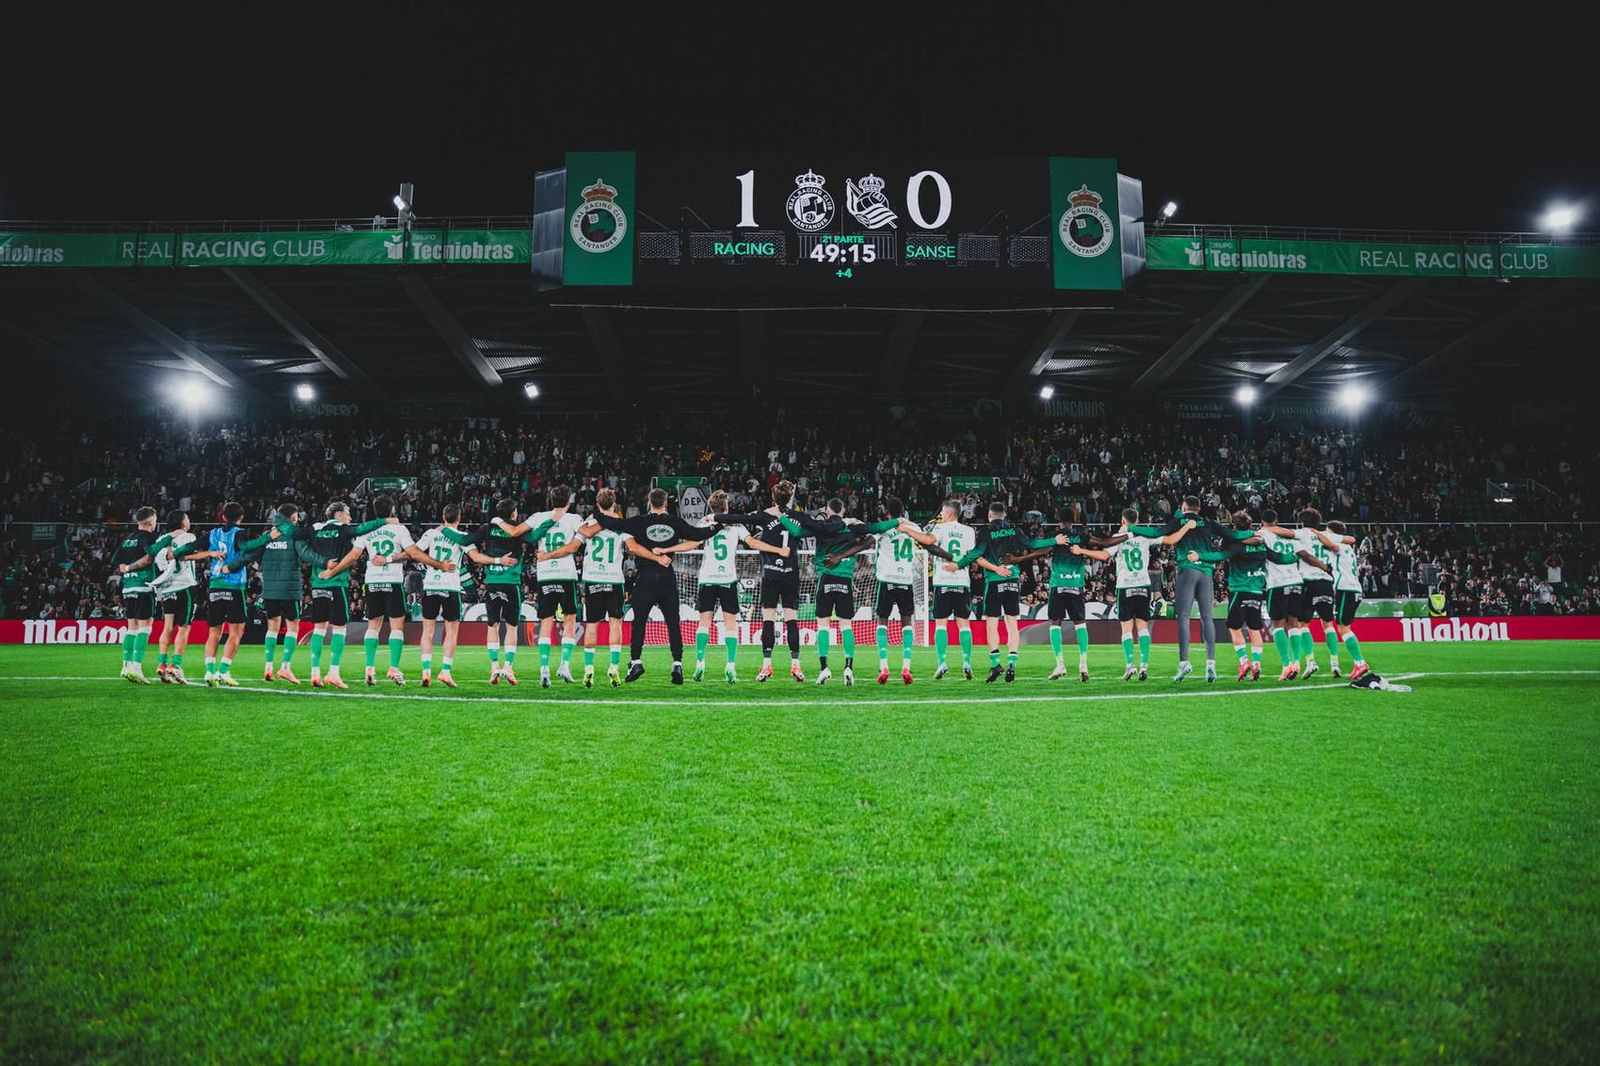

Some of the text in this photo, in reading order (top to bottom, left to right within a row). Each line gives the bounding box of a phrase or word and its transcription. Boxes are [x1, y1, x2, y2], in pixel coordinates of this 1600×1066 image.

[735, 169, 759, 228] 1
[797, 187, 822, 199] RACING
[906, 170, 952, 230] 0
[574, 201, 624, 228] REAL RACING CLUB
[792, 217, 828, 230] SANTANDER
[1062, 207, 1111, 233] REAL RACING CLUB
[122, 240, 325, 258] REAL RACING CLUB
[412, 241, 514, 260] Tecniobras
[577, 236, 618, 250] SANTANDER
[714, 242, 775, 256] RACING
[906, 245, 956, 258] SANSE
[1067, 240, 1107, 254] SANTANDER
[810, 244, 876, 263] 49:15
[1212, 249, 1307, 269] Tecniobras
[1360, 251, 1549, 269] REAL RACING CLUB
[836, 268, 852, 278] +4
[780, 530, 789, 549] 1
[991, 529, 1016, 539] RACNG
[591, 536, 615, 563] 21
[713, 534, 728, 561] 5
[891, 538, 914, 562] 14
[948, 540, 961, 557] 6
[1122, 548, 1144, 571] 18
[1400, 617, 1510, 641] Mahou
